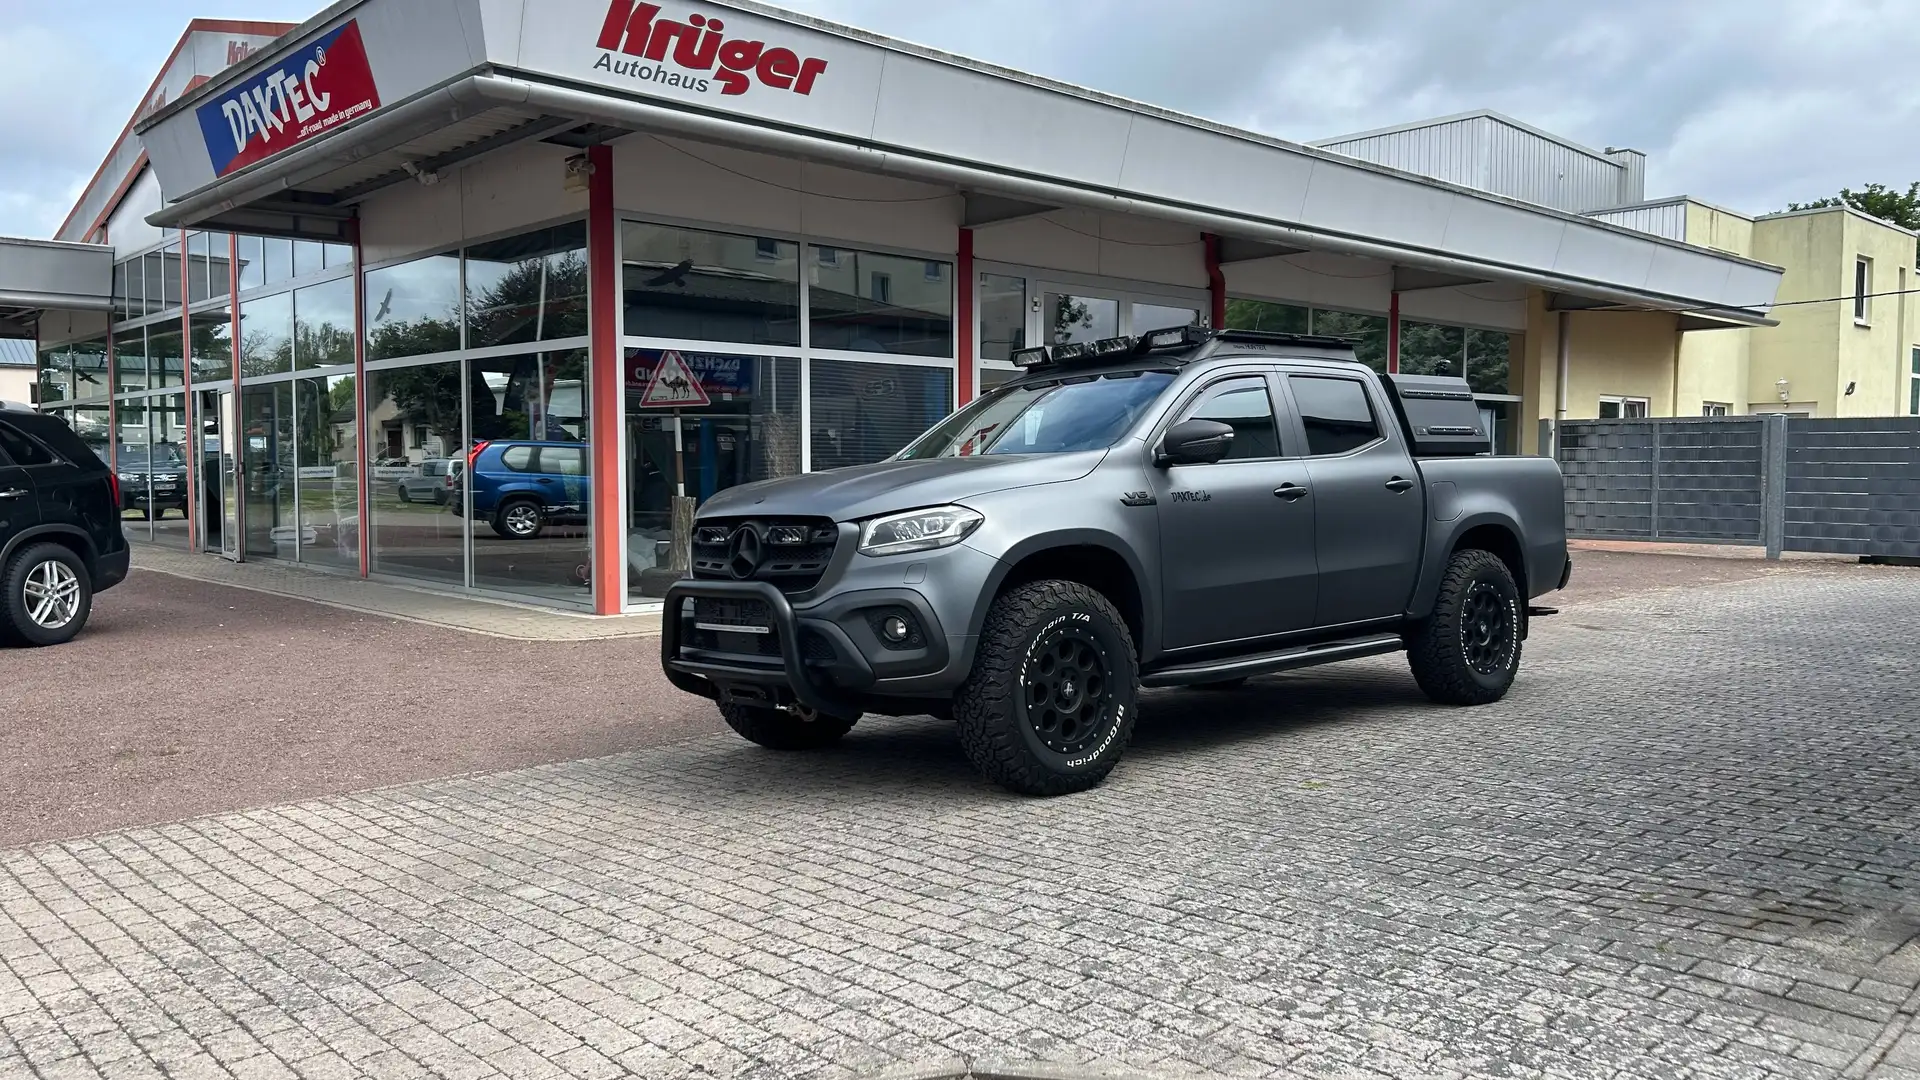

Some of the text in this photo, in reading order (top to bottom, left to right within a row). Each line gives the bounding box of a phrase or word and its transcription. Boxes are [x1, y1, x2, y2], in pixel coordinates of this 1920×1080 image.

[596, 0, 828, 96] Krüger
[593, 52, 709, 93] Autohaus
[323, 112, 340, 127] made
[338, 110, 346, 120] in
[345, 99, 373, 119] germany
[1072, 611, 1091, 622] T/A
[1066, 703, 1125, 768] BFGoodrich
